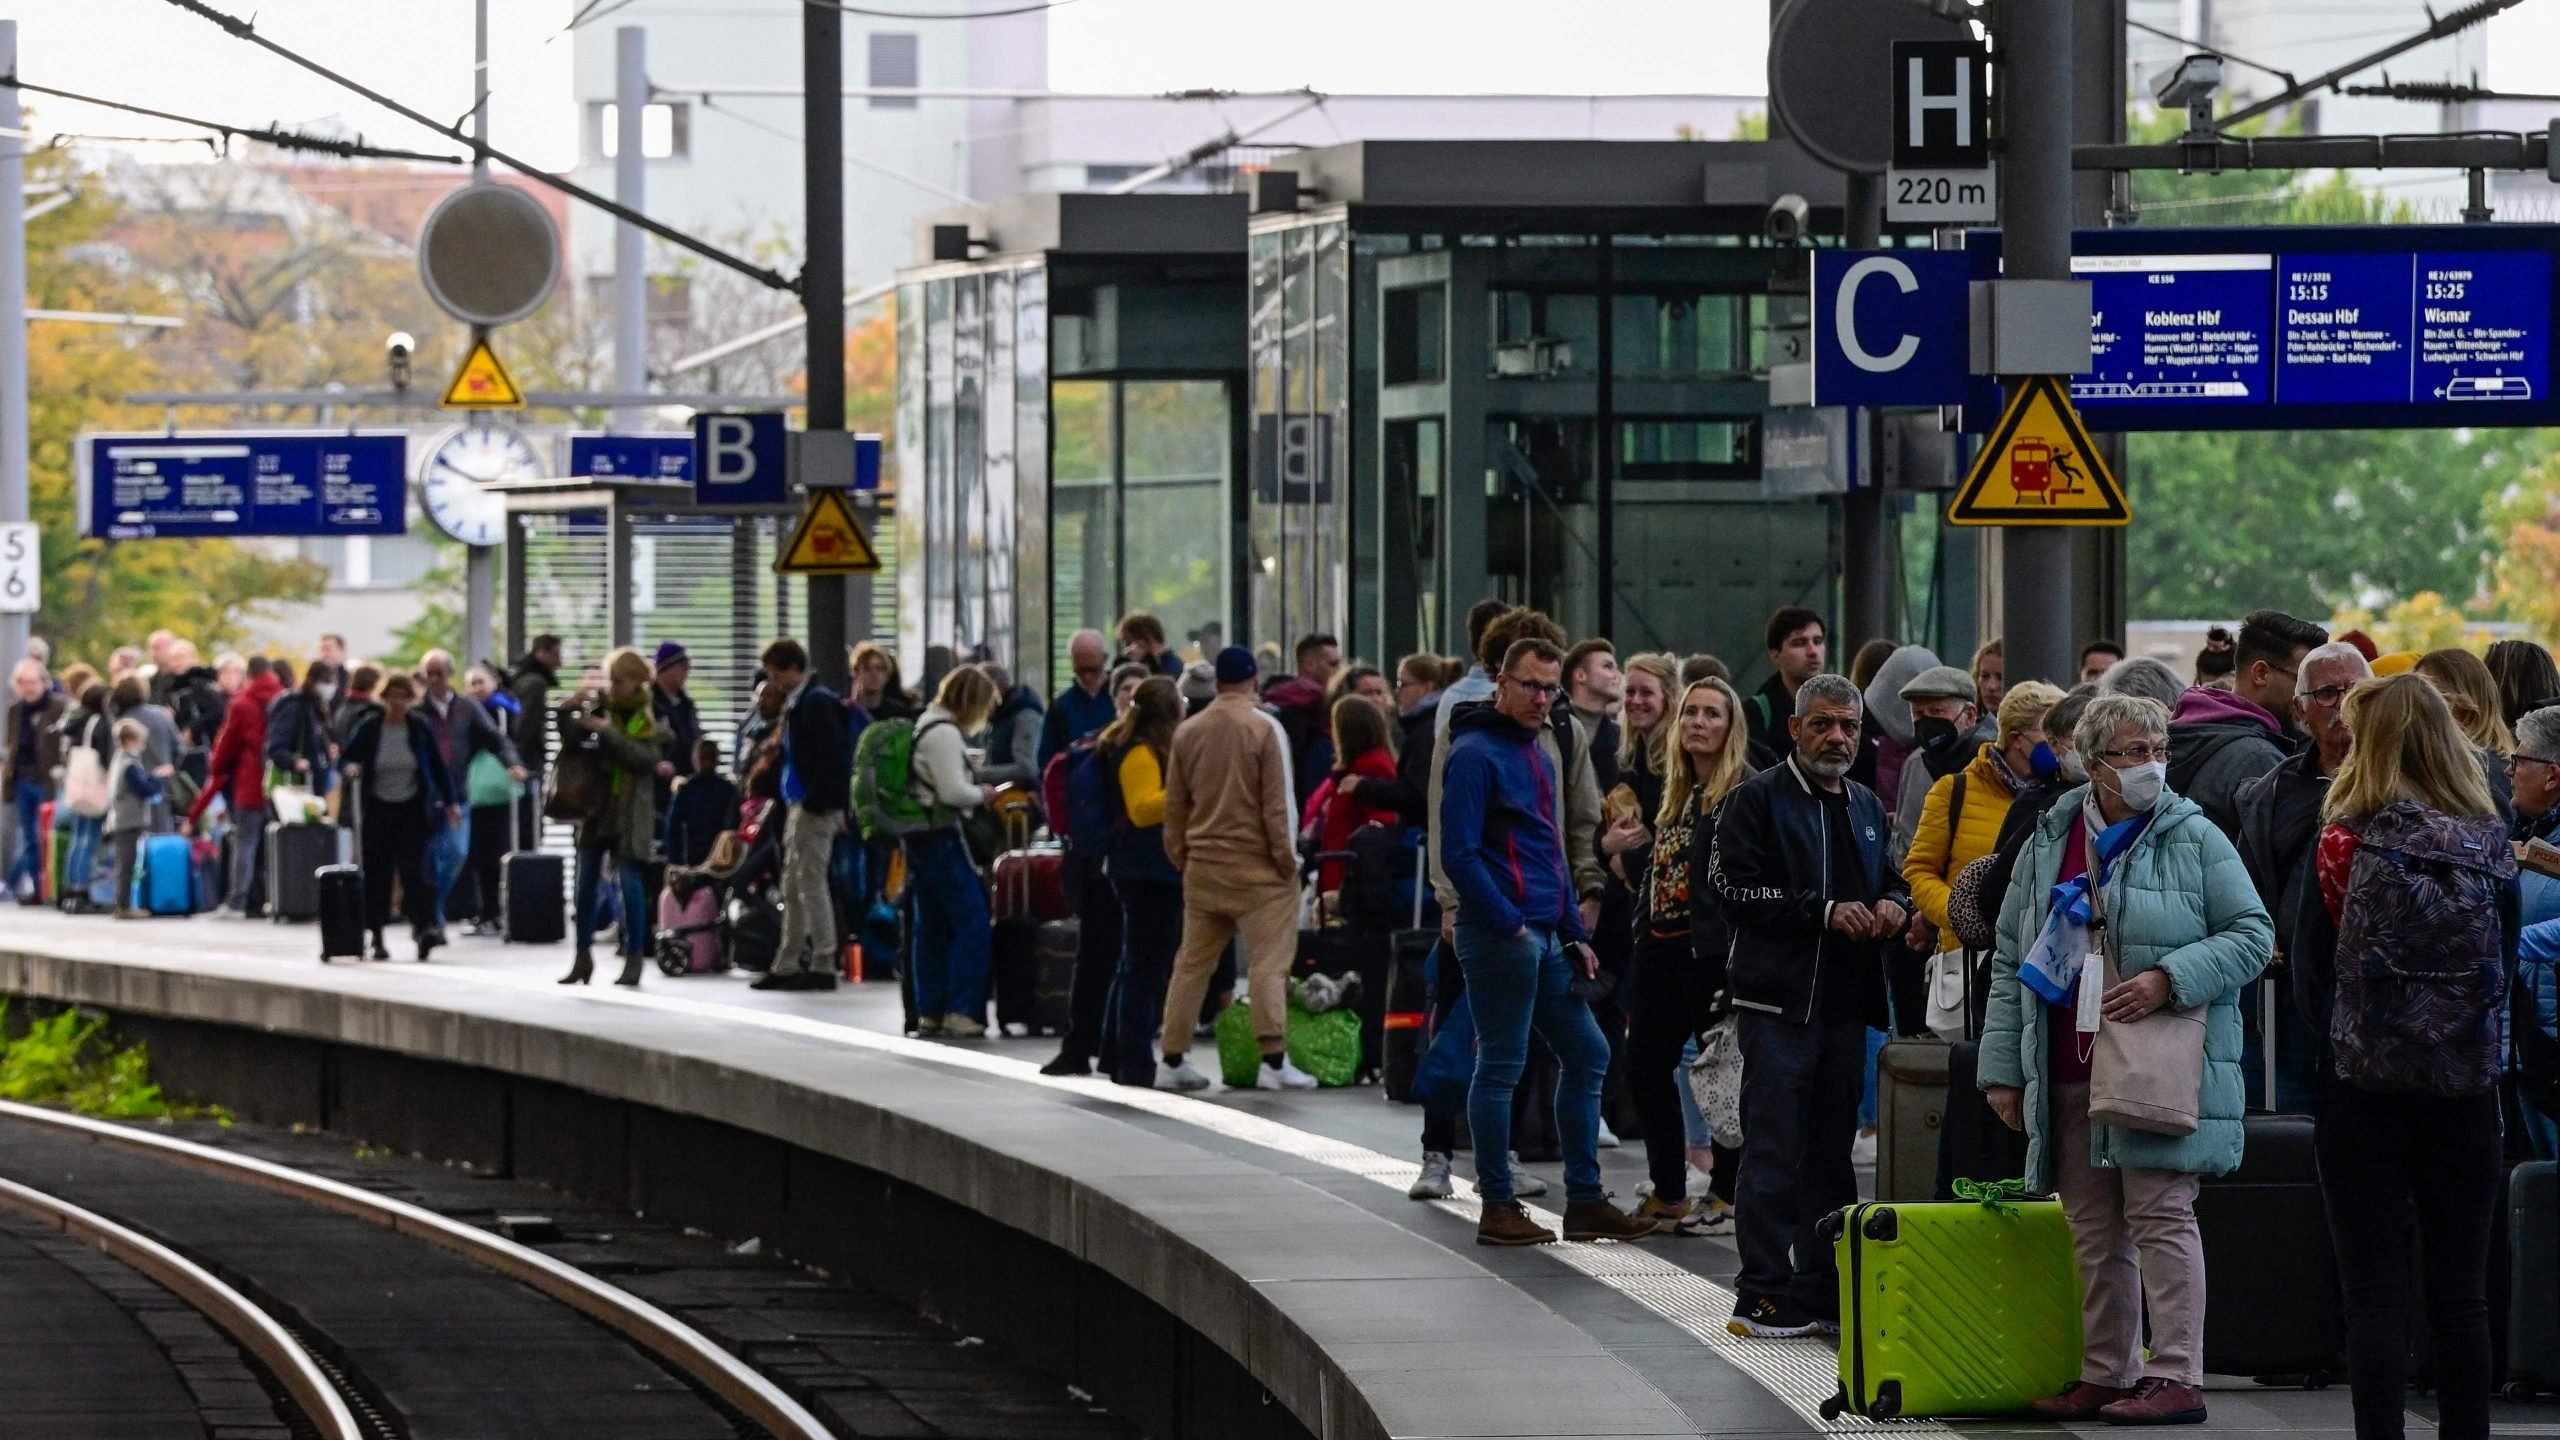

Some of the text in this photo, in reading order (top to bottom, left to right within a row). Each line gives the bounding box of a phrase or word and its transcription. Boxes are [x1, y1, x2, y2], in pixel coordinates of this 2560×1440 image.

[1908, 56, 1971, 148] H
[1897, 178, 1986, 204] 220 m
[2148, 274, 2160, 284] ICE
[2290, 284, 2328, 300] 15:15
[2426, 283, 2464, 299] 15:25
[1835, 256, 1921, 373] C
[2145, 309, 2221, 326] Koblenz Hbf
[2288, 308, 2359, 324] Dessau Hbf
[2424, 307, 2471, 323] Wismar
[2144, 330, 2251, 342] Hannover Hbf Bielefeld Hbf
[2350, 330, 2384, 340] Wannsee
[2144, 342, 2259, 355] Hamm (Westf) Hbf Hagen
[2353, 340, 2396, 351] Michendorf
[2423, 339, 2501, 352] Nauen Wittenberge
[2144, 353, 2259, 367] Hbf Wuppertal Hbf Köln Hbf
[2332, 352, 2347, 363] Bad
[2423, 350, 2524, 364] Ludwigslust Schwerin Hbf
[706, 416, 758, 485] B
[4, 529, 26, 561] 5
[4, 568, 27, 598] 6
